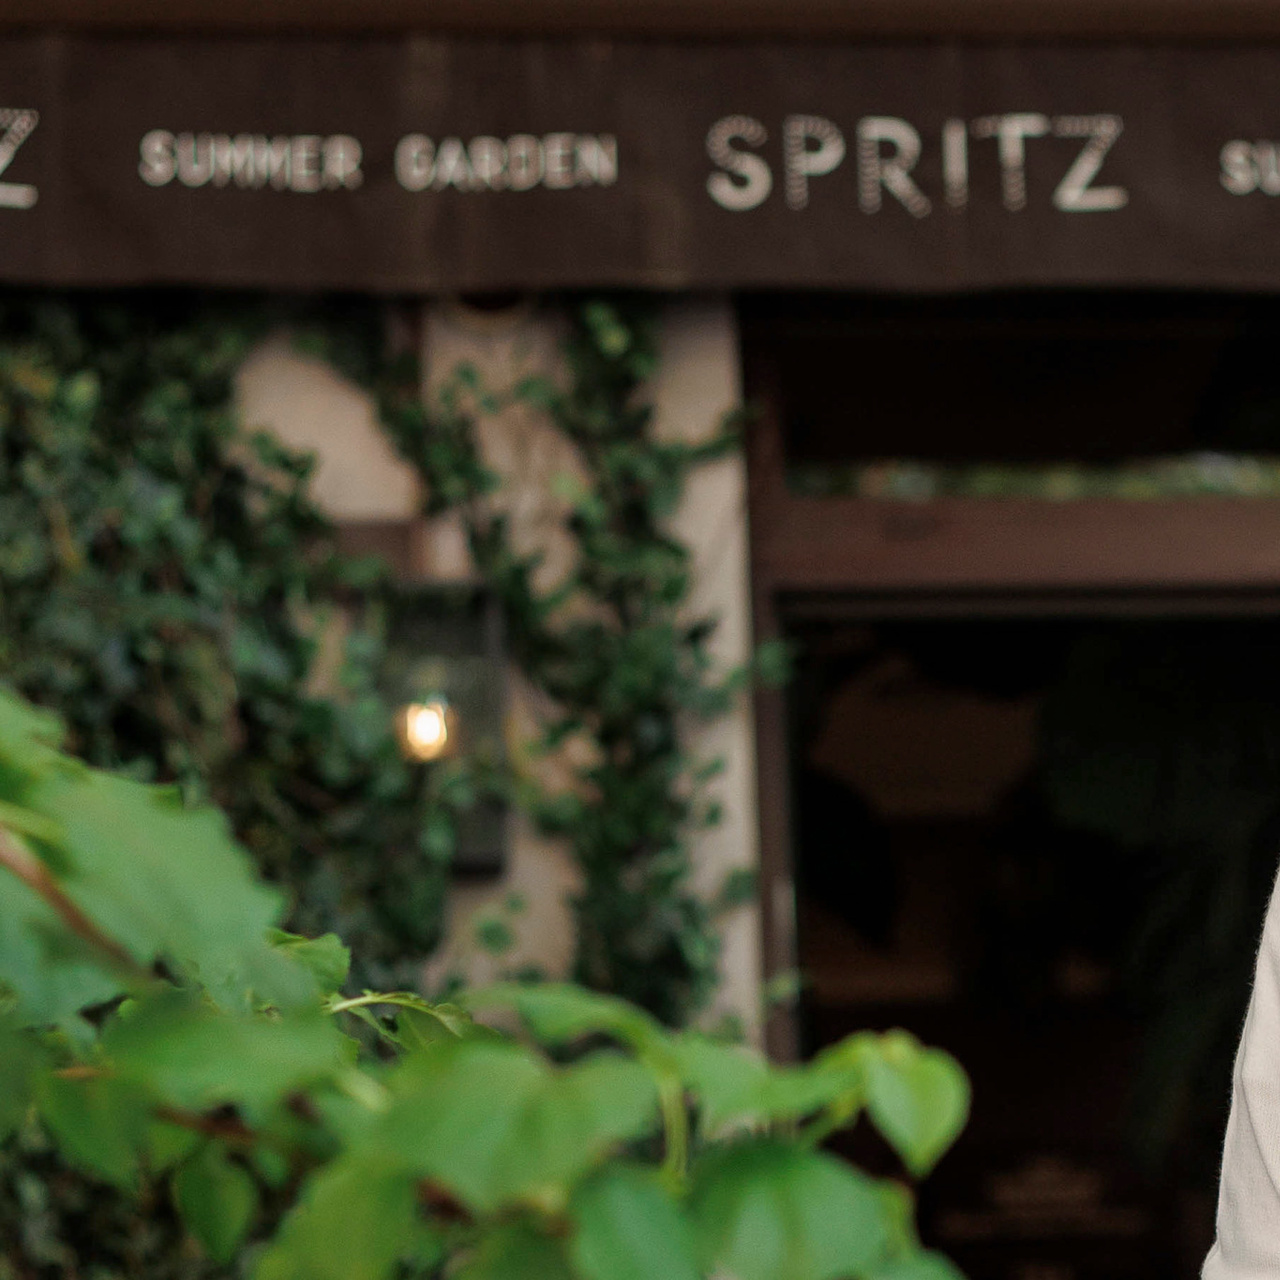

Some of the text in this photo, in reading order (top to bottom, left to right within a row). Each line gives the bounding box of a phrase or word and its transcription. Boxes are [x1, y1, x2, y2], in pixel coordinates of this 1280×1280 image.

[138, 128, 619, 193] SUMMER GARDEN
[705, 113, 1128, 218] SPRITZ
